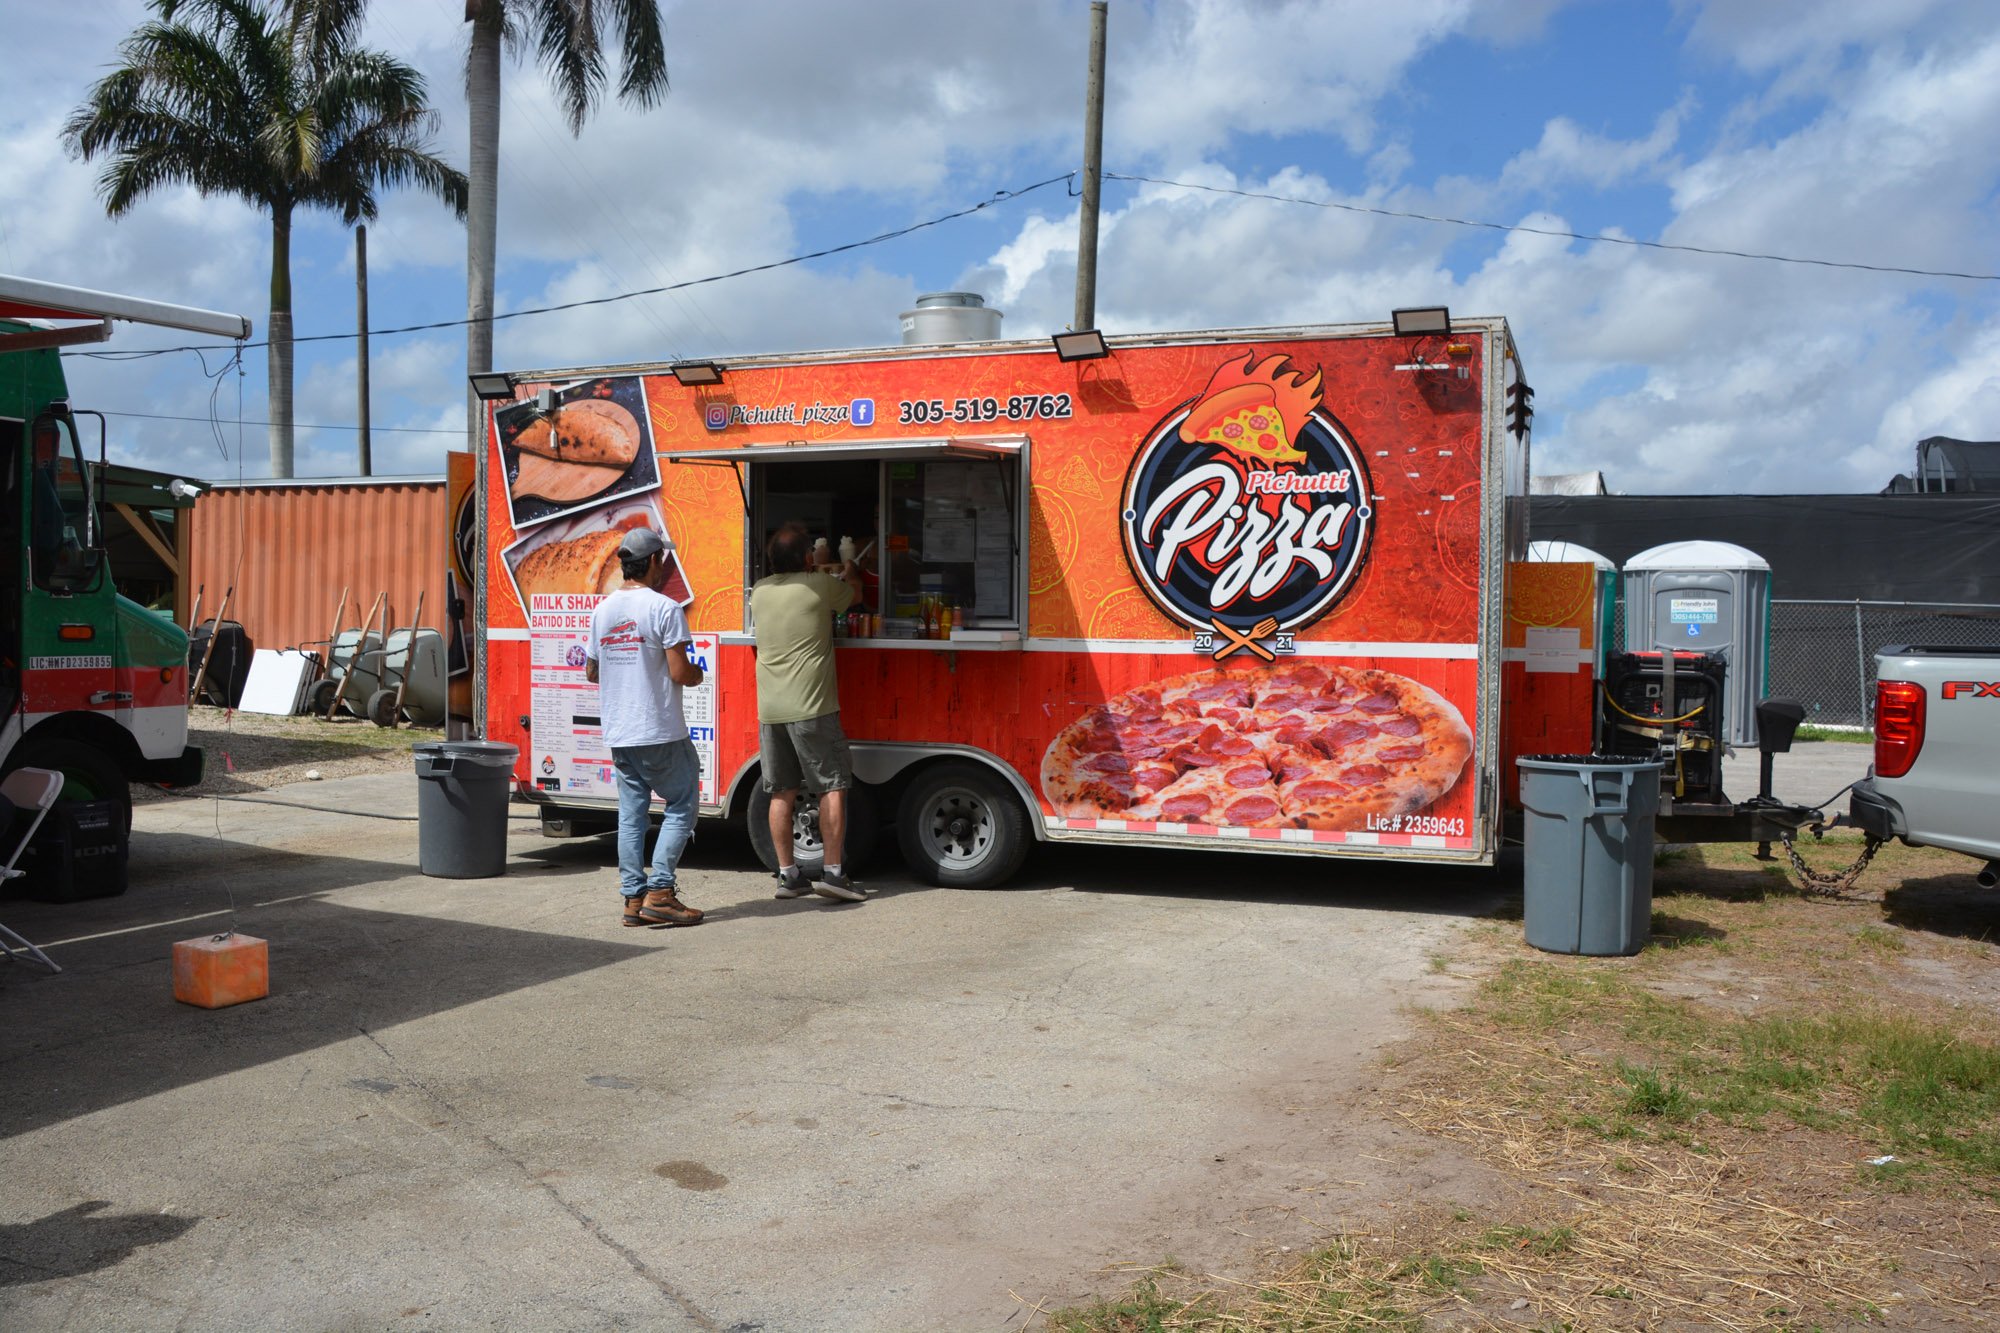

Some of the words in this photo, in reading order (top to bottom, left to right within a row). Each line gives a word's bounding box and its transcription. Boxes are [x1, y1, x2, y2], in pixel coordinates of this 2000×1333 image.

[729, 403, 849, 426] Pichutti_pizza
[899, 394, 1072, 424] 305-519-8762
[1247, 470, 1351, 493] Pichutti
[1141, 462, 1354, 609] Pizza
[533, 596, 564, 610] MILK
[567, 596, 609, 610] SHAK
[532, 615, 563, 628] BATIDO
[565, 616, 577, 628] DE
[1194, 635, 1213, 649] 20
[1276, 636, 1295, 650] 21
[1404, 815, 1465, 836] 2359643
